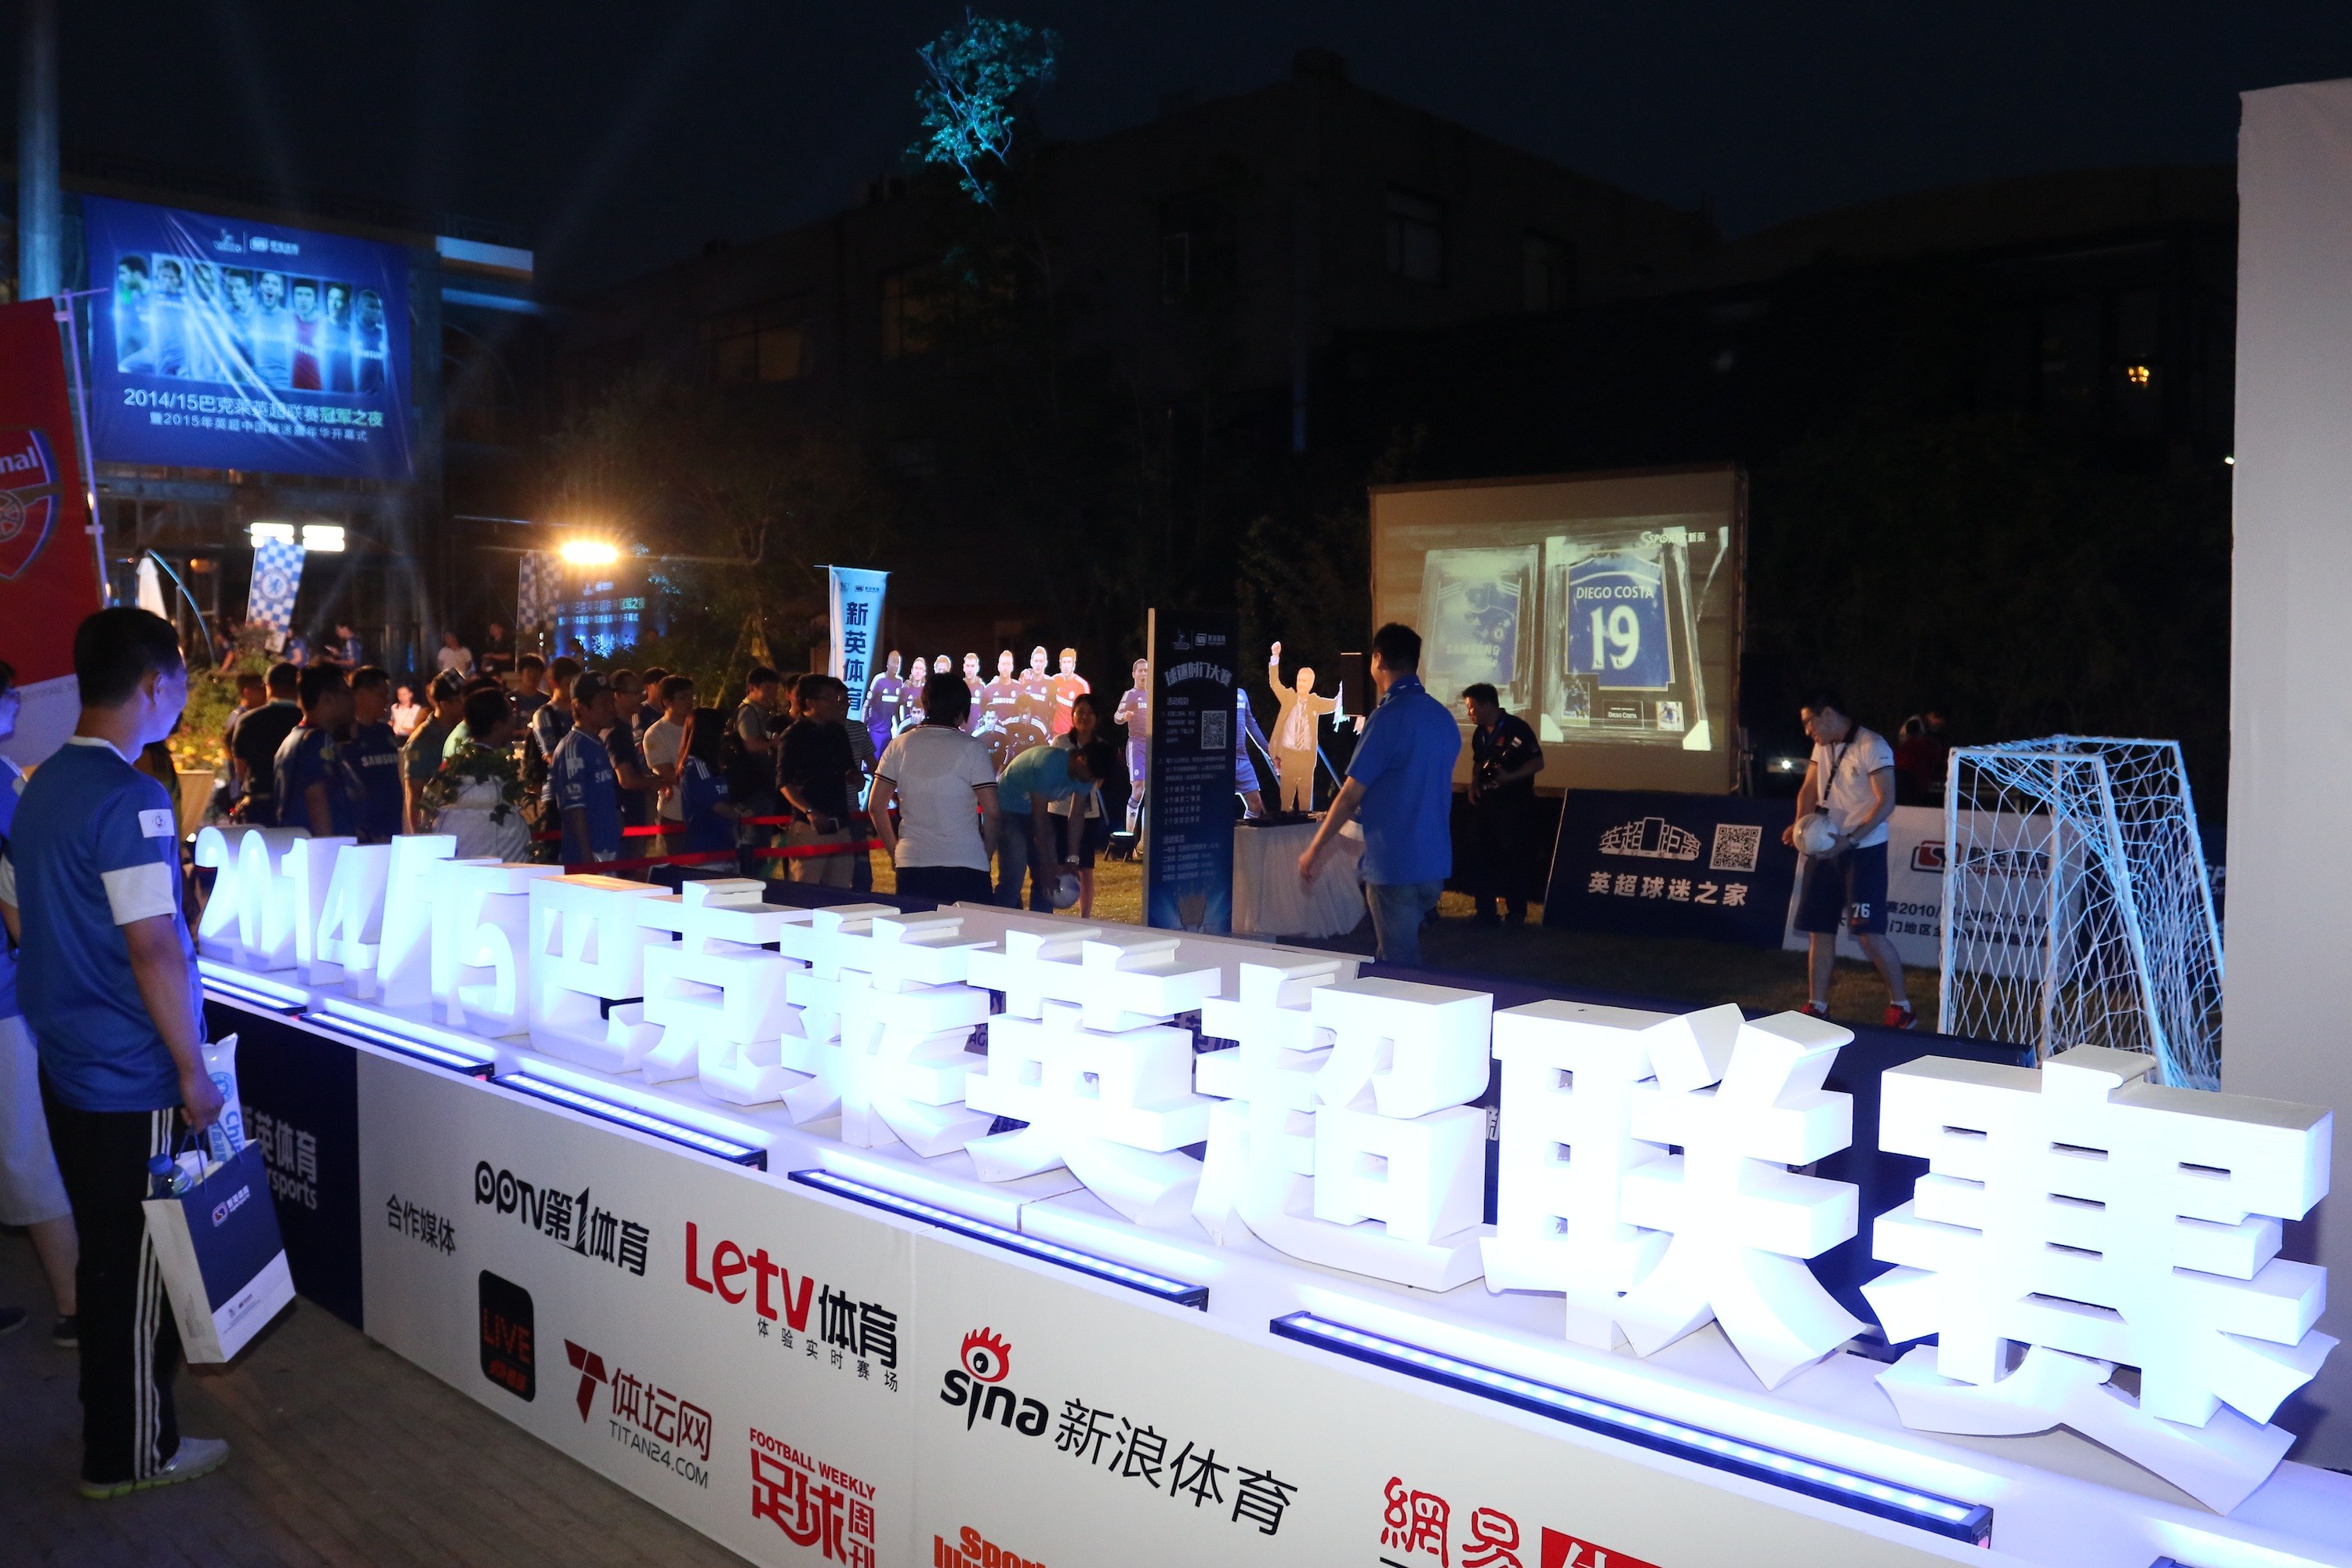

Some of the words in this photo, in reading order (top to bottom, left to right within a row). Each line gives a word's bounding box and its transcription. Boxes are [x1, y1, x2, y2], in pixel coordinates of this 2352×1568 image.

[1576, 586, 1612, 599] DIEGO
[1614, 586, 1655, 599] COSTA
[843, 602, 868, 711] 新英体育
[1446, 644, 1500, 656] SAMSUNG
[1590, 604, 1640, 670] 19
[361, 753, 398, 768] SAMSUN
[1588, 871, 1748, 907] 英超球迷之家
[1852, 903, 1871, 918] 76
[387, 1194, 456, 1256] 合作媒体
[482, 1307, 531, 1365] LIVE
[757, 1318, 898, 1392] 体验实时赛场
[612, 1367, 713, 1462] 体坛网
[609, 1419, 709, 1489] TITAN24.COM
[750, 1427, 815, 1474] FOOTBALL
[818, 1461, 877, 1501] WEEKLY
[940, 1369, 1050, 1437] sina
[1054, 1398, 1298, 1536] 新浪体育
